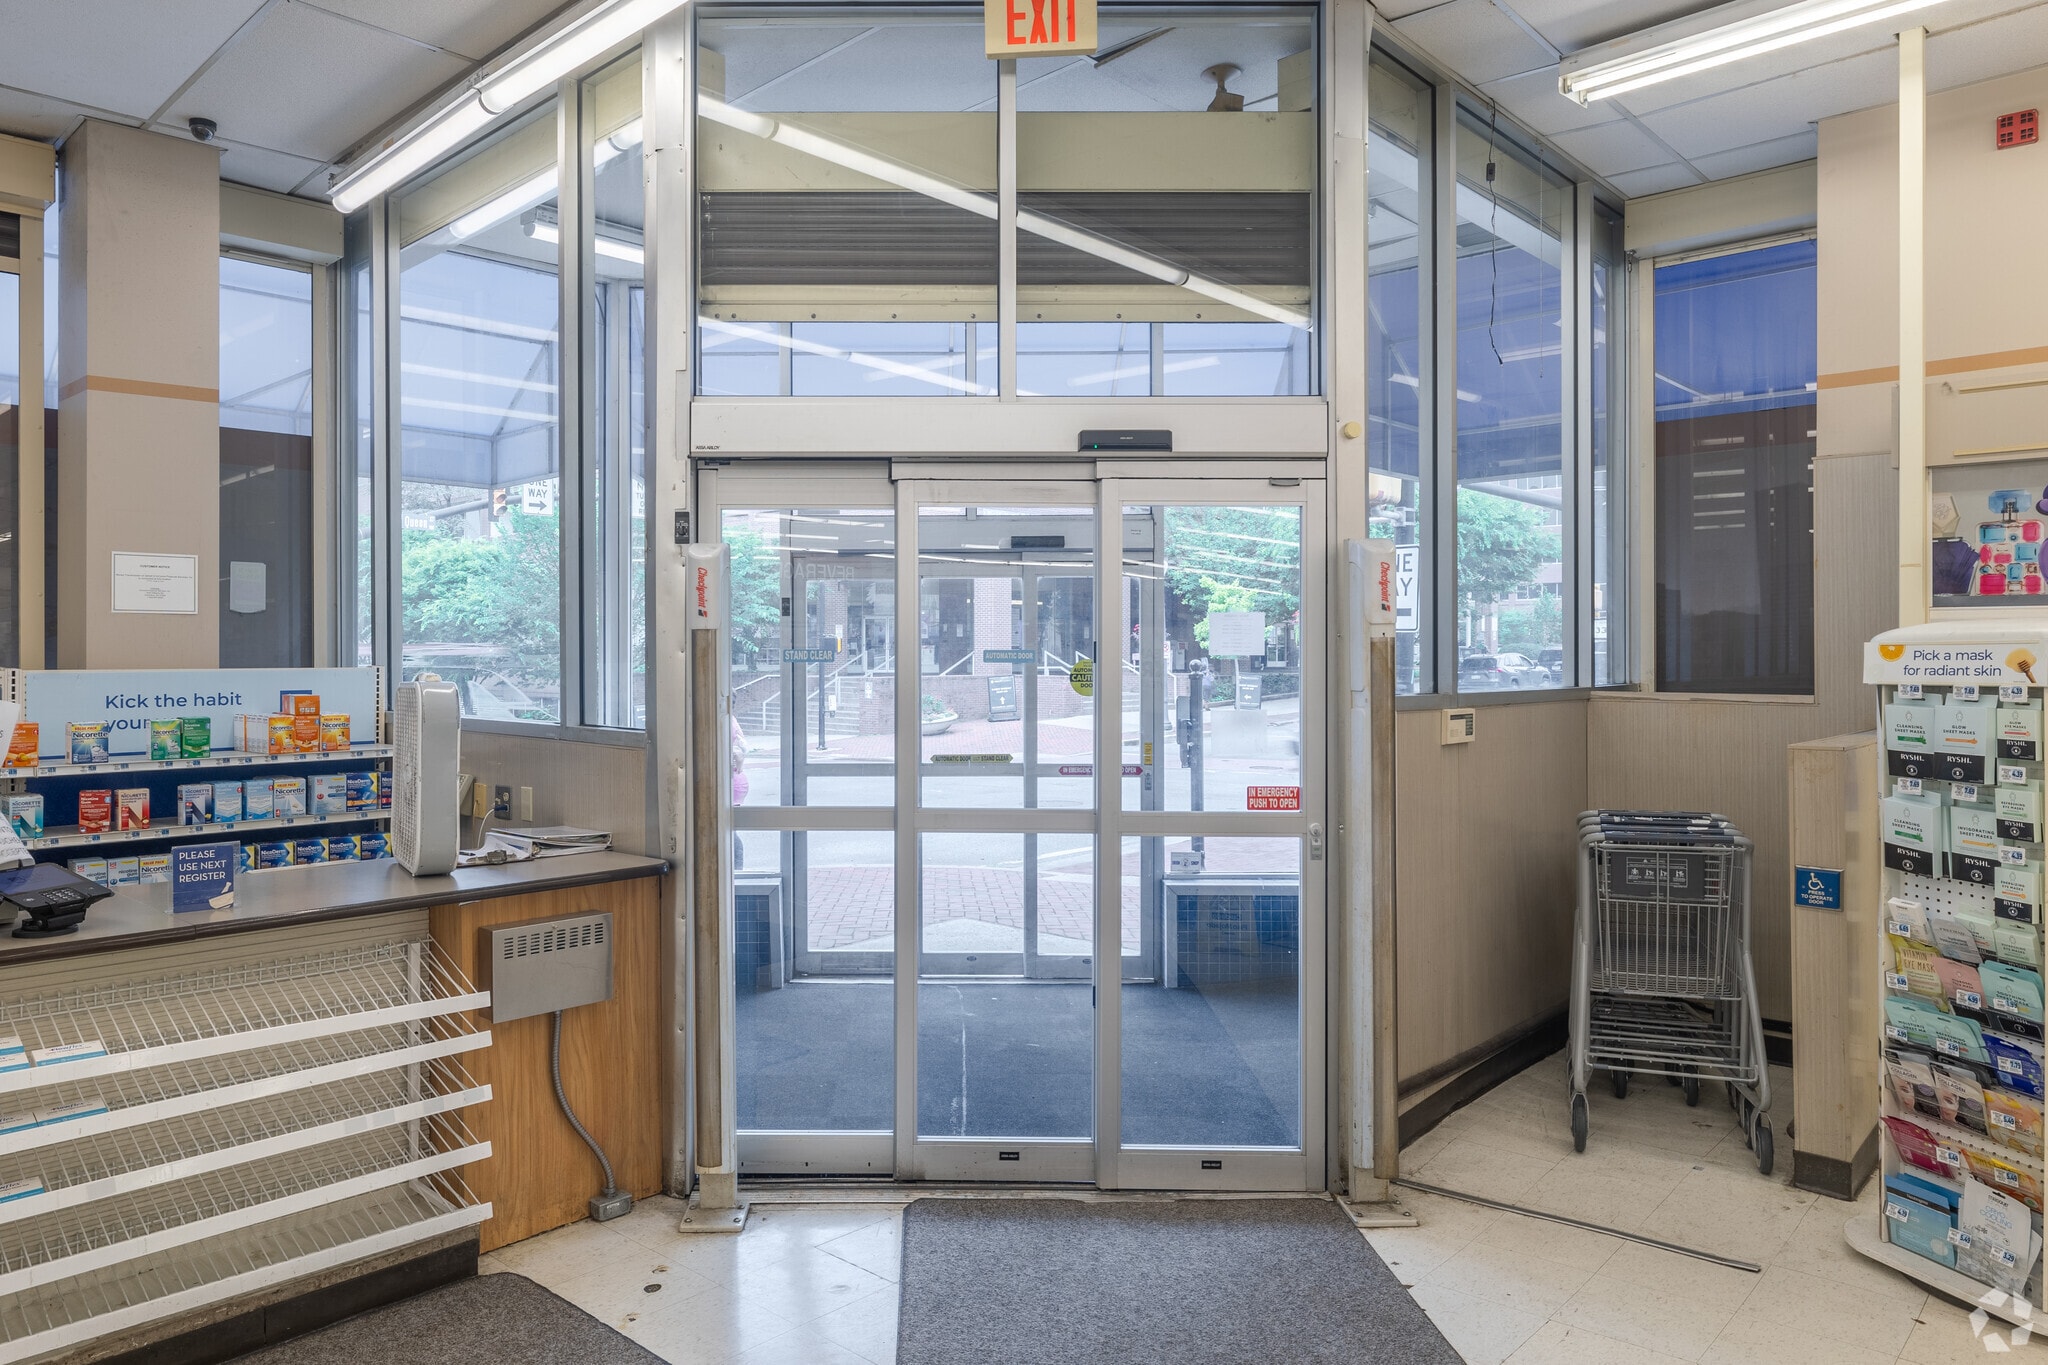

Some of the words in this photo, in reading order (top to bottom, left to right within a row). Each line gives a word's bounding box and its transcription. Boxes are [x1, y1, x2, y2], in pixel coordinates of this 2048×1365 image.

[528, 488, 548, 498] WAY
[1379, 562, 1390, 602] Checkpoint
[696, 567, 708, 608] Checkpoint
[785, 650, 808, 660] STAND
[810, 650, 832, 660] CLEAR
[1913, 650, 1940, 660] Pick
[1944, 652, 1951, 660] a
[1956, 649, 1993, 660] mask
[1904, 665, 1920, 675] for
[1924, 665, 1970, 676] radiant
[1974, 665, 2002, 676] skin
[106, 694, 149, 709] Kick
[154, 693, 187, 708] the
[193, 692, 242, 707] habit
[1249, 788, 1256, 797] IN
[1258, 788, 1298, 797] EMERGENCY
[1250, 798, 1267, 808] PUSH
[1269, 798, 1277, 808] TO
[1280, 798, 1297, 808] OPEN
[1894, 818, 1920, 827] CLEANSING
[1958, 826, 1994, 835] INVIGORATING
[179, 850, 215, 860] PLEASE
[179, 862, 197, 871] USE
[201, 860, 227, 870] NEXT
[179, 872, 226, 883] REGISTER
[1903, 950, 1927, 961] VITAMIN
[1904, 960, 1915, 969] EYE
[1917, 962, 1936, 973] MASK
[1948, 1043, 1959, 1051] 2.99
[1960, 1234, 1971, 1244] 5.49
[2003, 1252, 2014, 1262] 3.29
